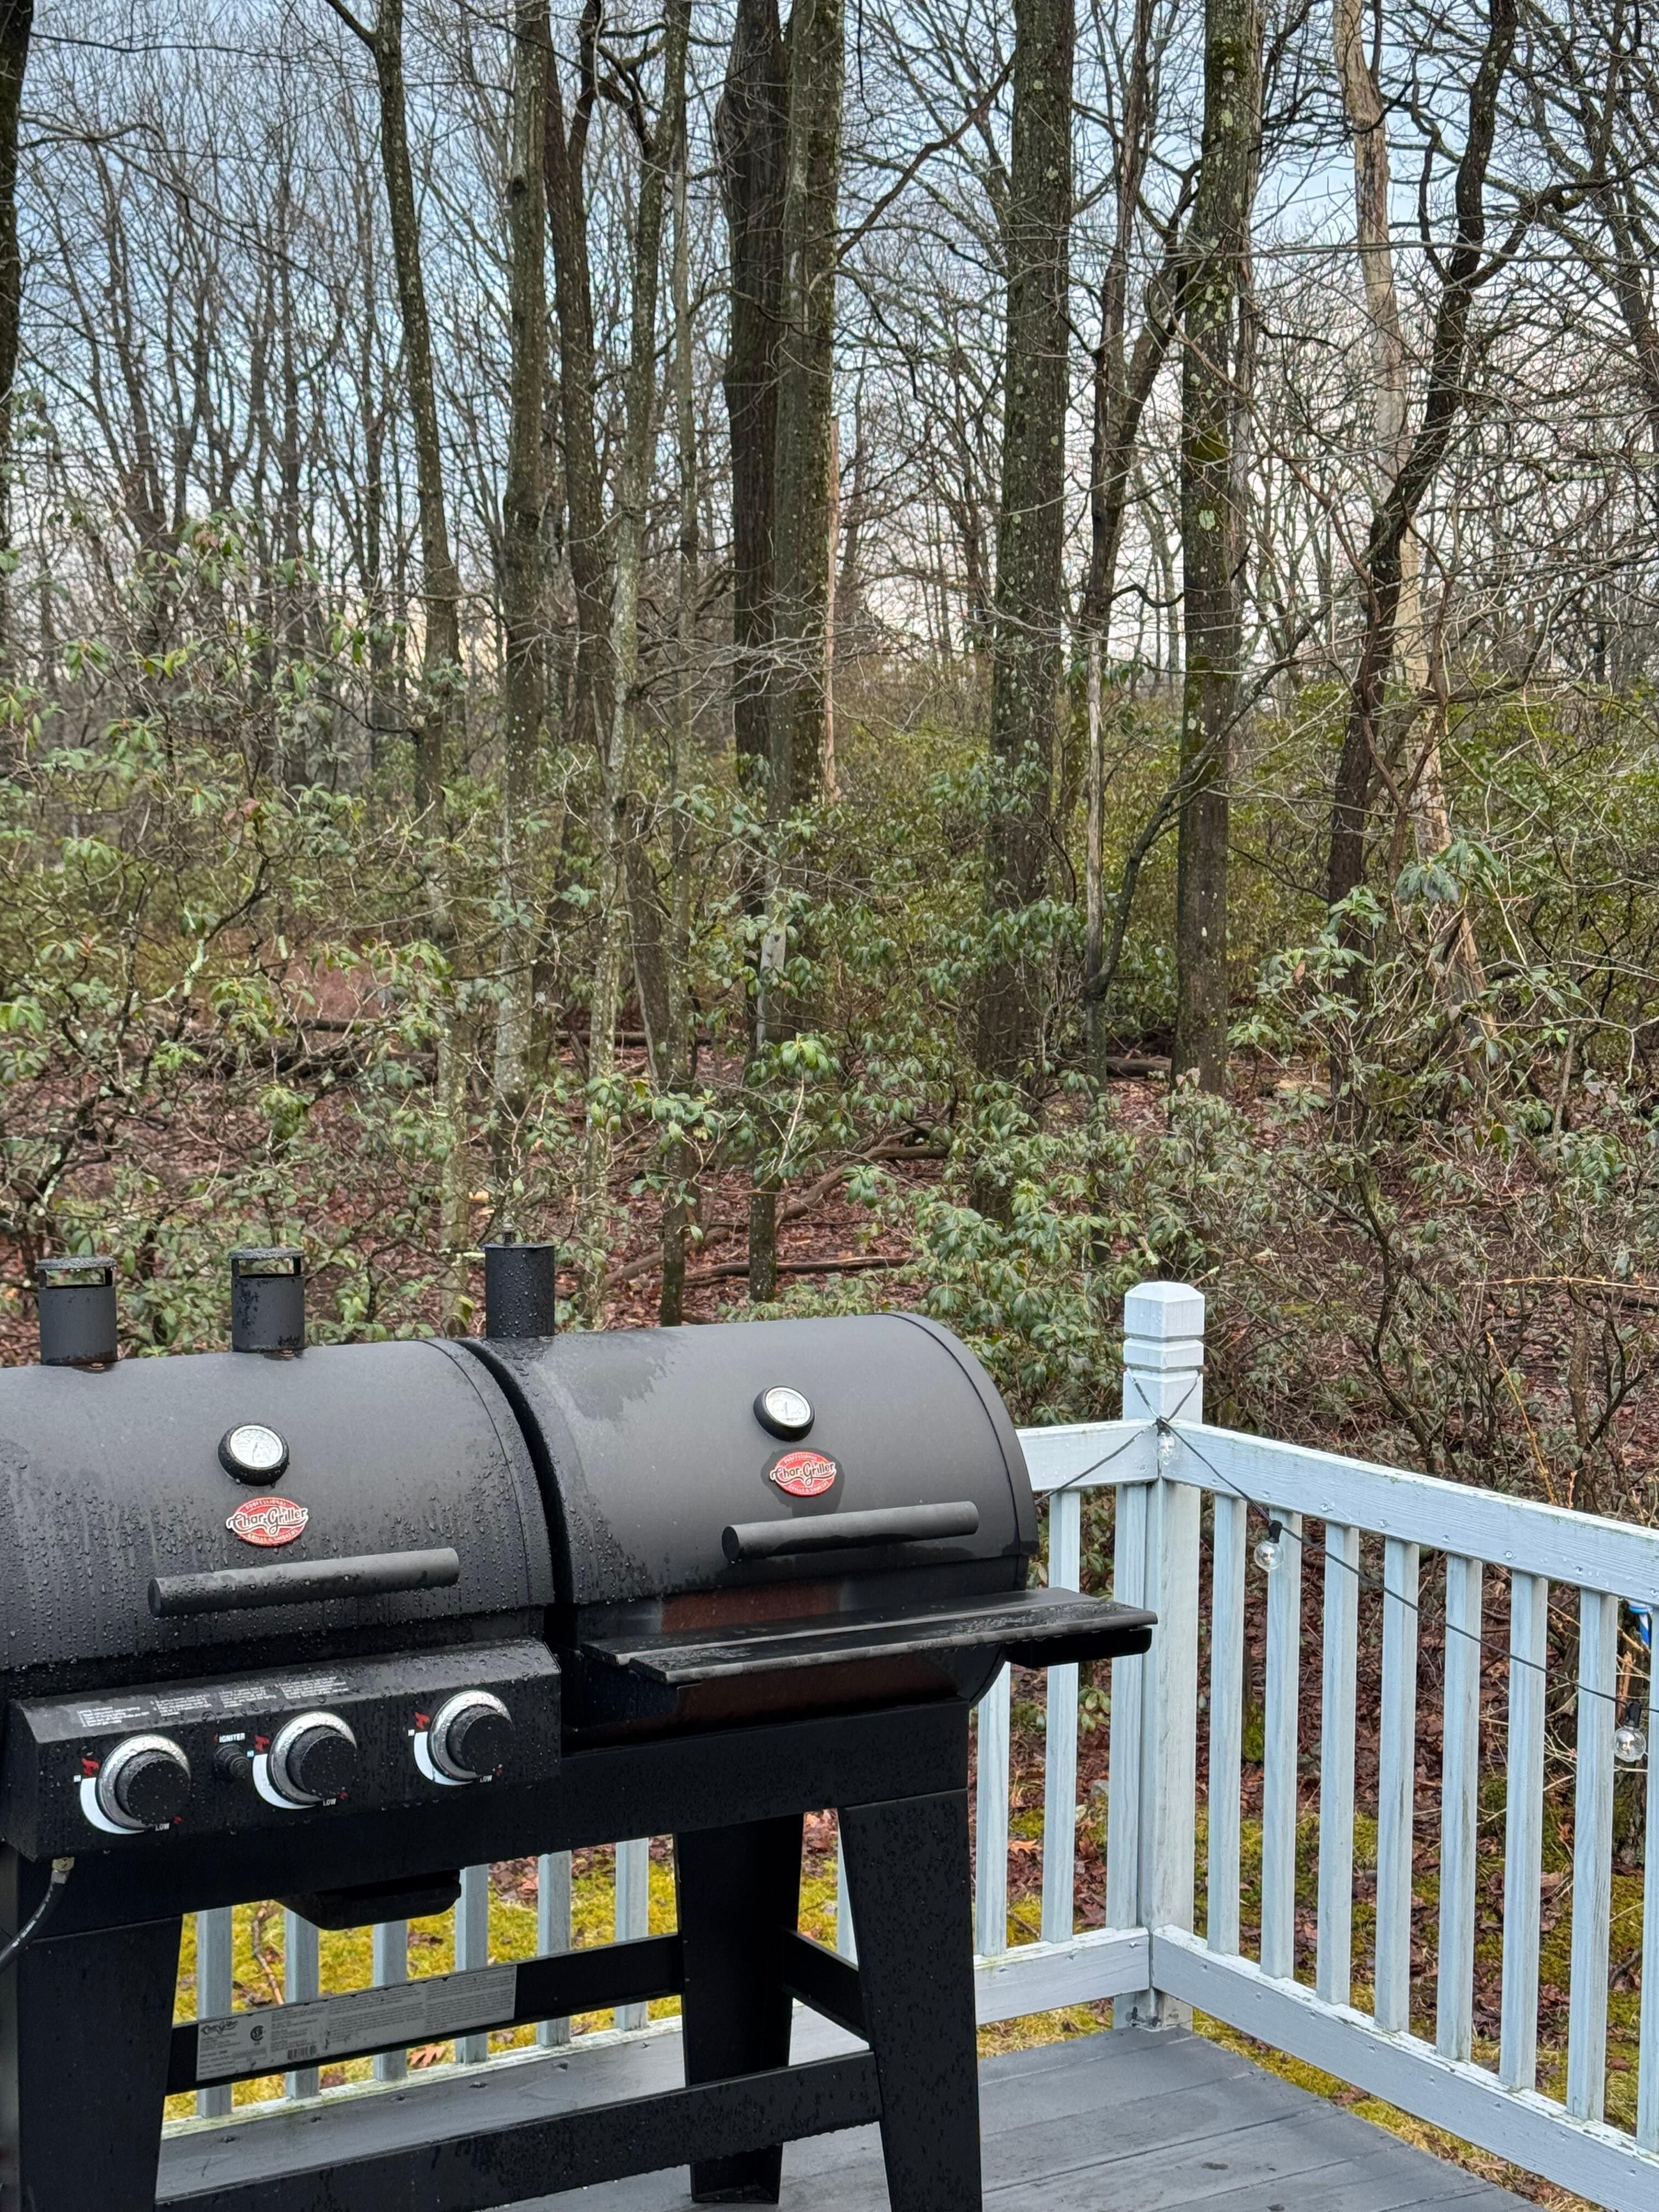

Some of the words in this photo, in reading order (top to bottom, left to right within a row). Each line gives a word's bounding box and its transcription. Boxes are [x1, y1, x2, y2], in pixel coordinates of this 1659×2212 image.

[219, 1733, 246, 1743] IGNITER
[479, 1775, 493, 1783] LOW
[323, 1798, 336, 1807] LOW
[155, 1822, 170, 1832] LOW
